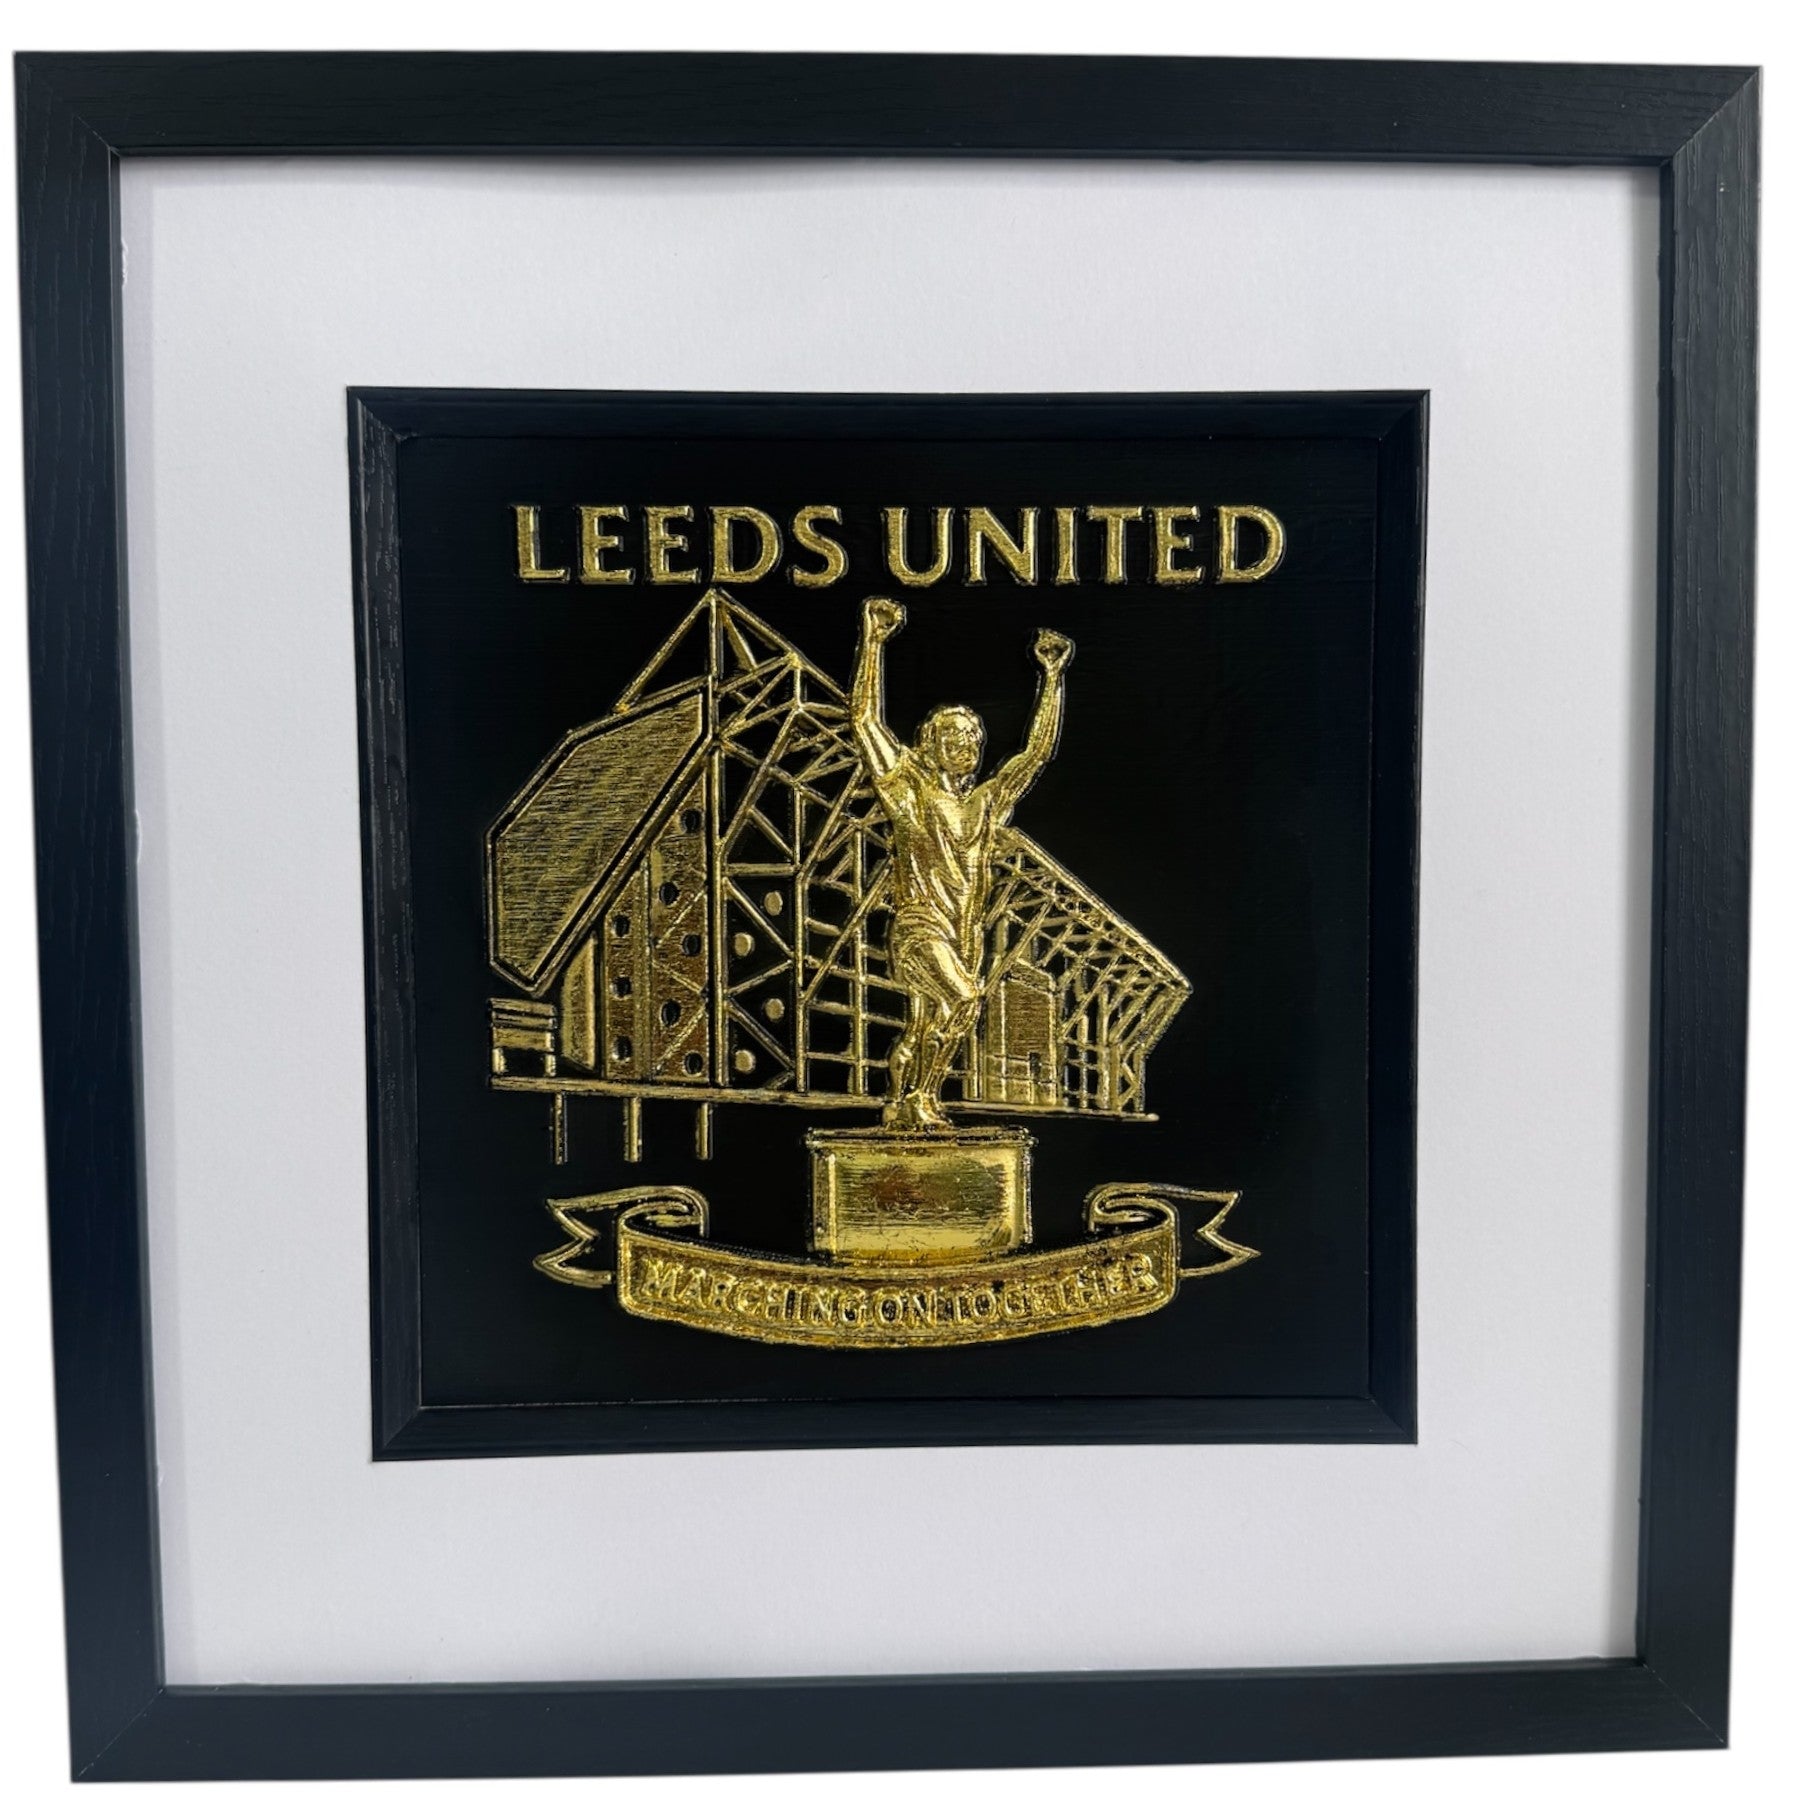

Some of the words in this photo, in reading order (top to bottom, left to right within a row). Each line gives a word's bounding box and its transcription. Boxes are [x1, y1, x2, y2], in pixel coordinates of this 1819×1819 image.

[513, 504, 848, 585] LEEDS
[883, 504, 1288, 587] UNITED
[641, 1258, 867, 1328] MARCHING
[872, 1286, 939, 1328] ON
[945, 1255, 1159, 1325] TOGETHER
